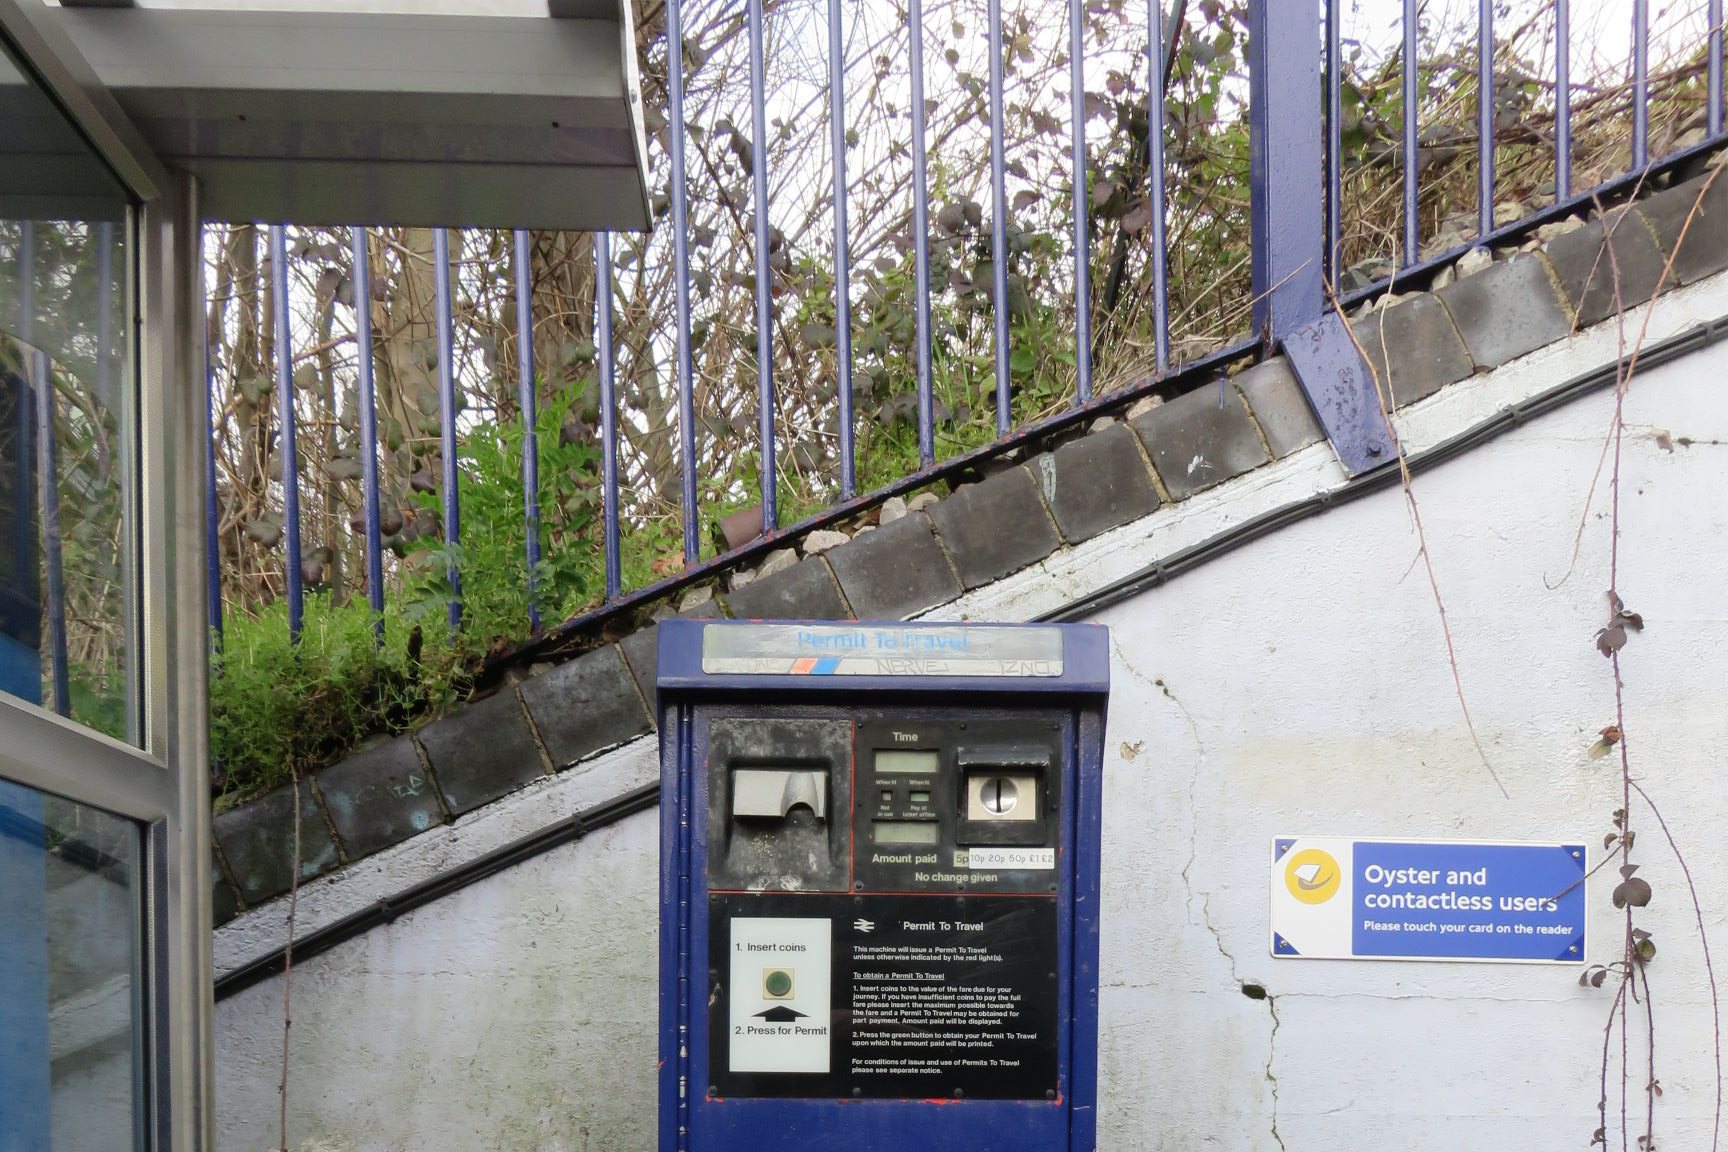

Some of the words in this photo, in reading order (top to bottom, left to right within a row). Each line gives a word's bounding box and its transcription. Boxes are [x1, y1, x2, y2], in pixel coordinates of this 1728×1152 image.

[798, 631, 866, 649] Permit
[876, 631, 897, 649] To
[892, 731, 918, 741] Time
[872, 853, 912, 863] Amount
[915, 854, 937, 864] paid
[956, 854, 969, 864] 5p
[971, 855, 985, 863] 10p
[989, 855, 1004, 863] 20p
[1010, 855, 1025, 863] 50p
[915, 872, 930, 882] No
[931, 872, 969, 884] change
[970, 872, 998, 884] given
[1365, 865, 1440, 888] Oyster
[1446, 867, 1486, 886] and
[1364, 891, 1493, 910] contactless
[1500, 897, 1557, 911] users
[903, 921, 935, 931] Permit
[938, 921, 951, 931] To
[954, 921, 984, 931] Travel
[1364, 920, 1401, 931] Please
[1403, 921, 1437, 932] touch
[1440, 924, 1466, 934] your
[1468, 923, 1493, 933] card
[1496, 925, 1511, 933] on
[1514, 923, 1533, 934] the
[1536, 924, 1573, 934] reader
[736, 943, 742, 951] 1.
[747, 942, 776, 952] Insert
[779, 943, 806, 952] coins
[852, 993, 880, 1001] journey.
[867, 1001, 890, 1009] please
[957, 1002, 986, 1010] possible
[852, 1017, 867, 1025] part
[968, 1018, 1002, 1026] displayed.
[735, 1026, 744, 1034] 2.
[747, 1026, 776, 1035] Press
[778, 1026, 791, 1035] for
[795, 1026, 827, 1035] Permit
[930, 1040, 945, 1048] paid
